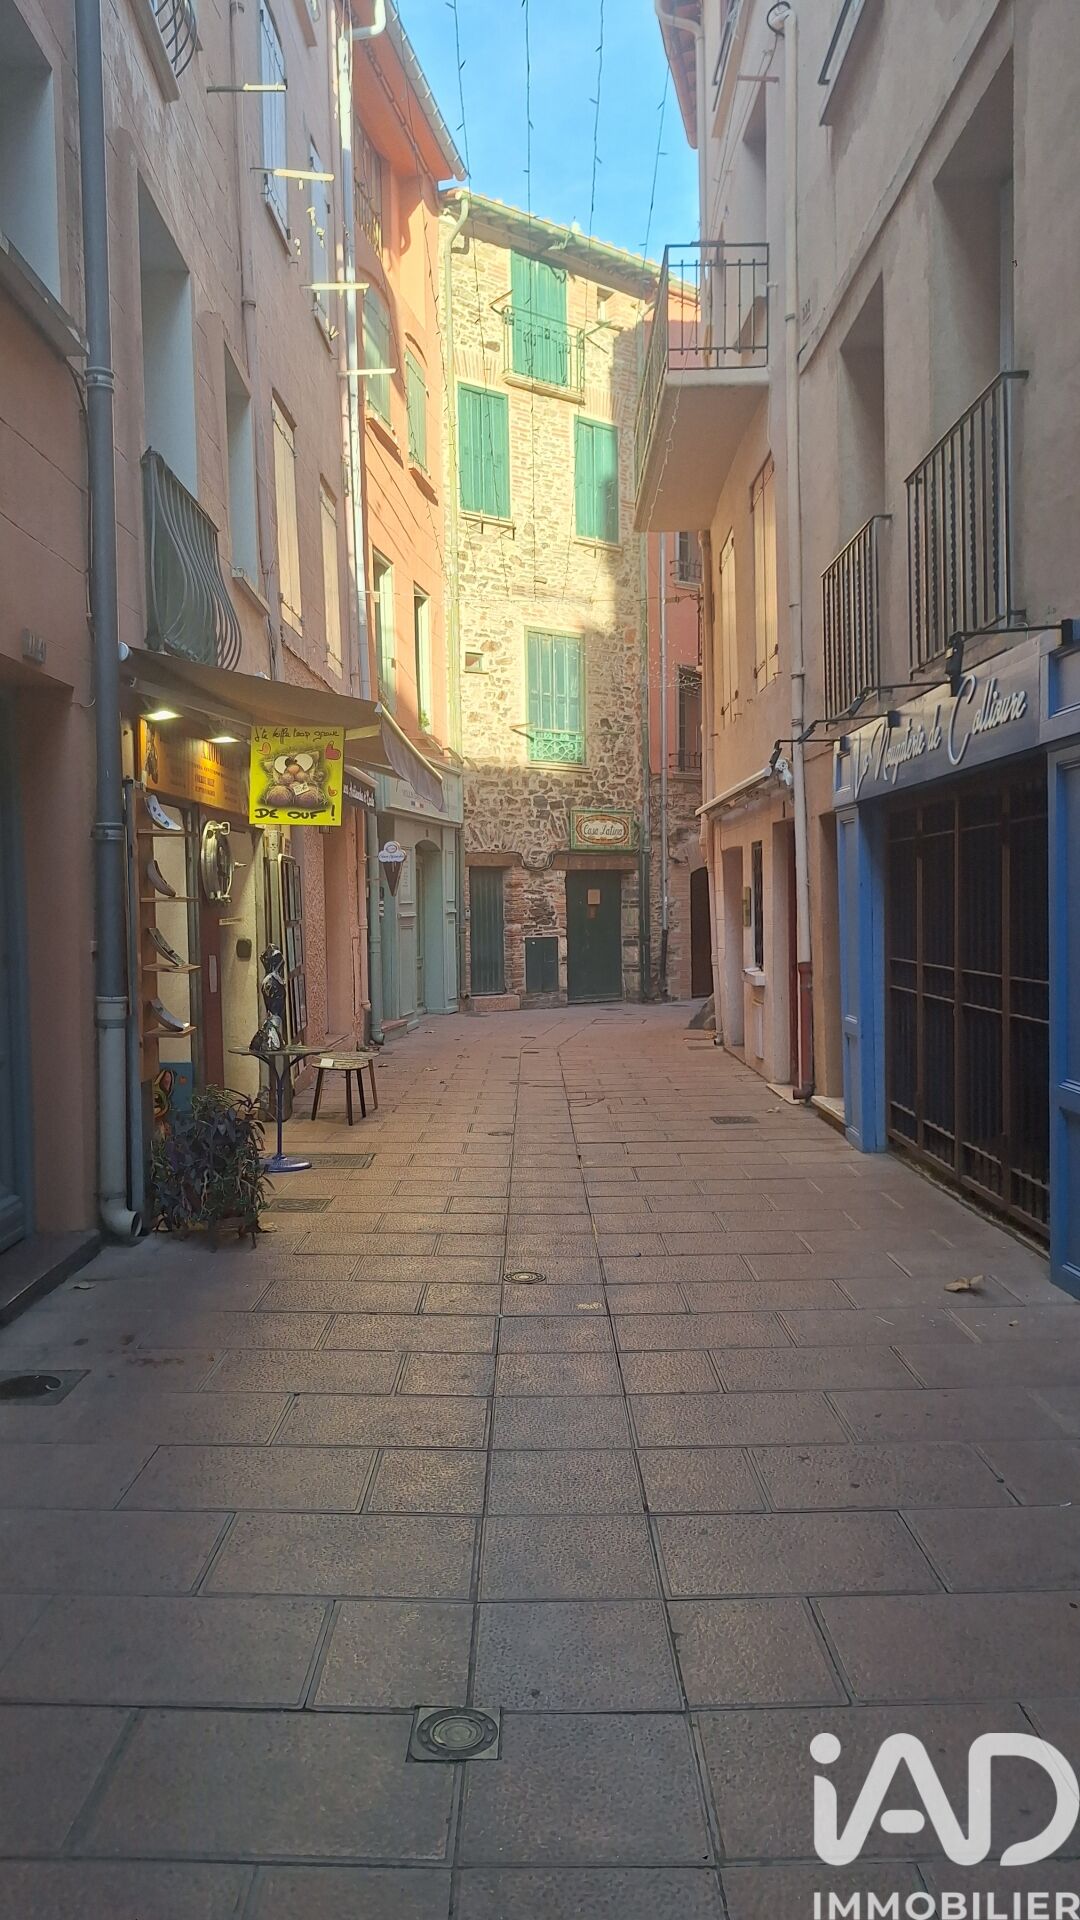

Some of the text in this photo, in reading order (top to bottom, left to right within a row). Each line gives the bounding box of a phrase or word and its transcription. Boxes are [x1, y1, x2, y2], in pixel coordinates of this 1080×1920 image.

[928, 704, 942, 752] de
[948, 674, 1027, 766] Collioure
[254, 808, 279, 819] DE
[287, 809, 327, 819] OUF
[584, 823, 599, 835] Casa
